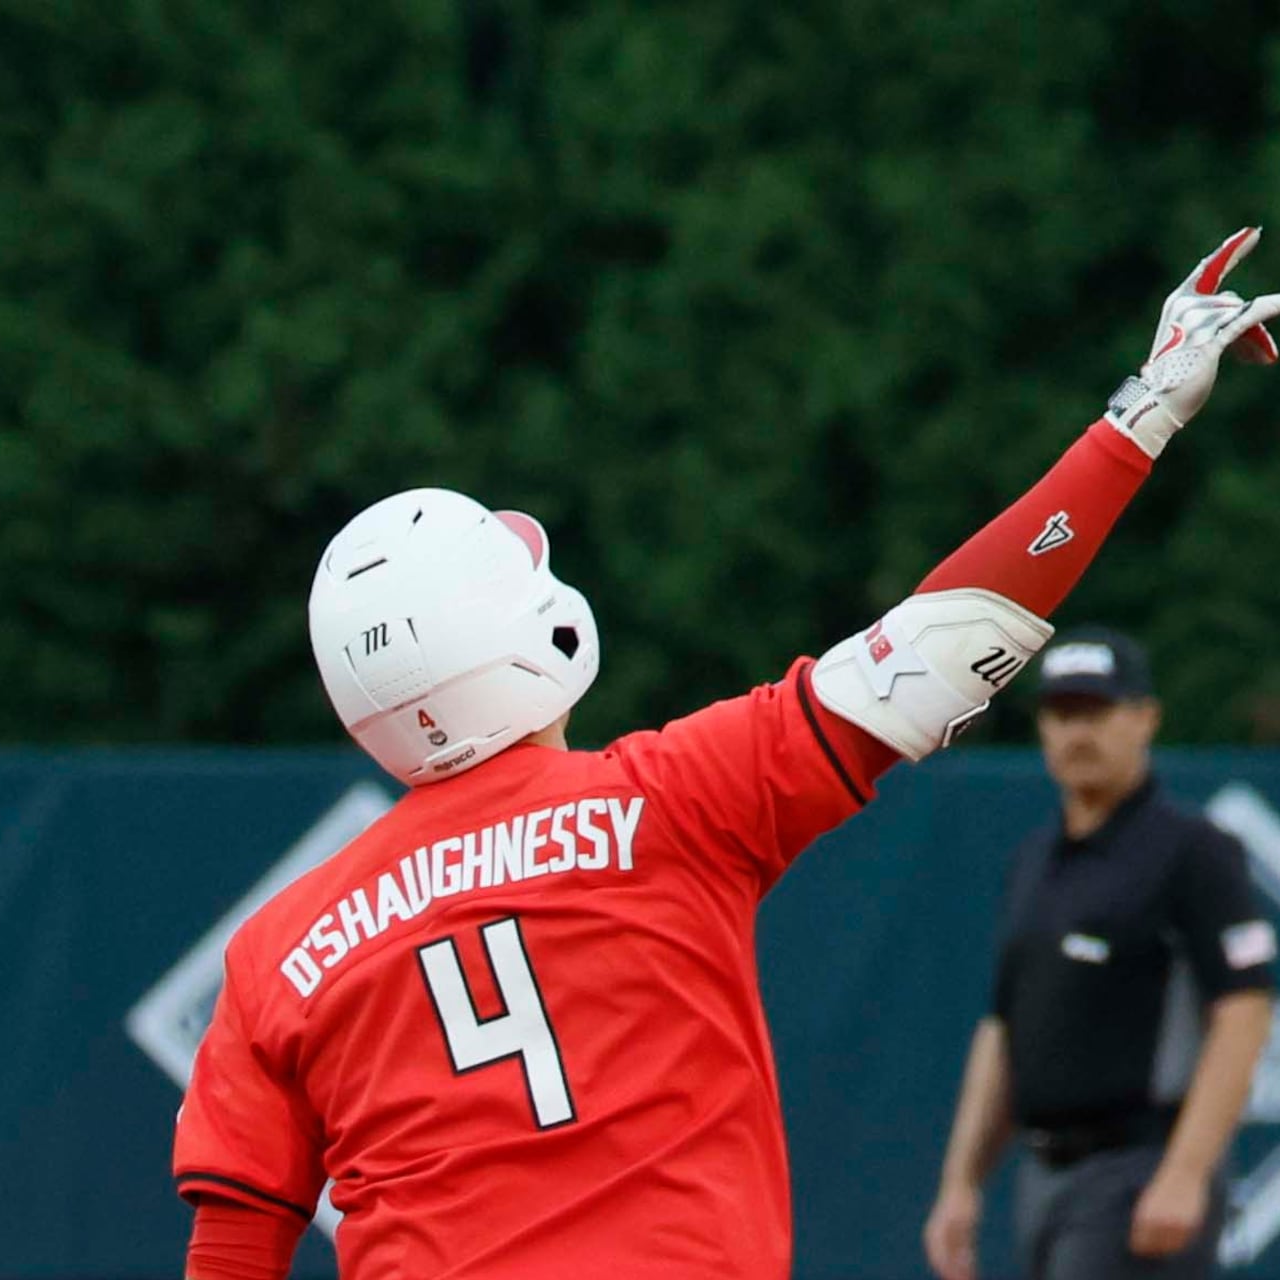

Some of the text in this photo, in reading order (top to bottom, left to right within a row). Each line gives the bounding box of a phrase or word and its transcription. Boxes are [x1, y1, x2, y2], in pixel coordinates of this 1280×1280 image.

[1028, 511, 1073, 555] 4
[418, 709, 435, 729] 4
[280, 796, 644, 998] O'SHAUGHNESSY
[416, 915, 577, 1132] 4
